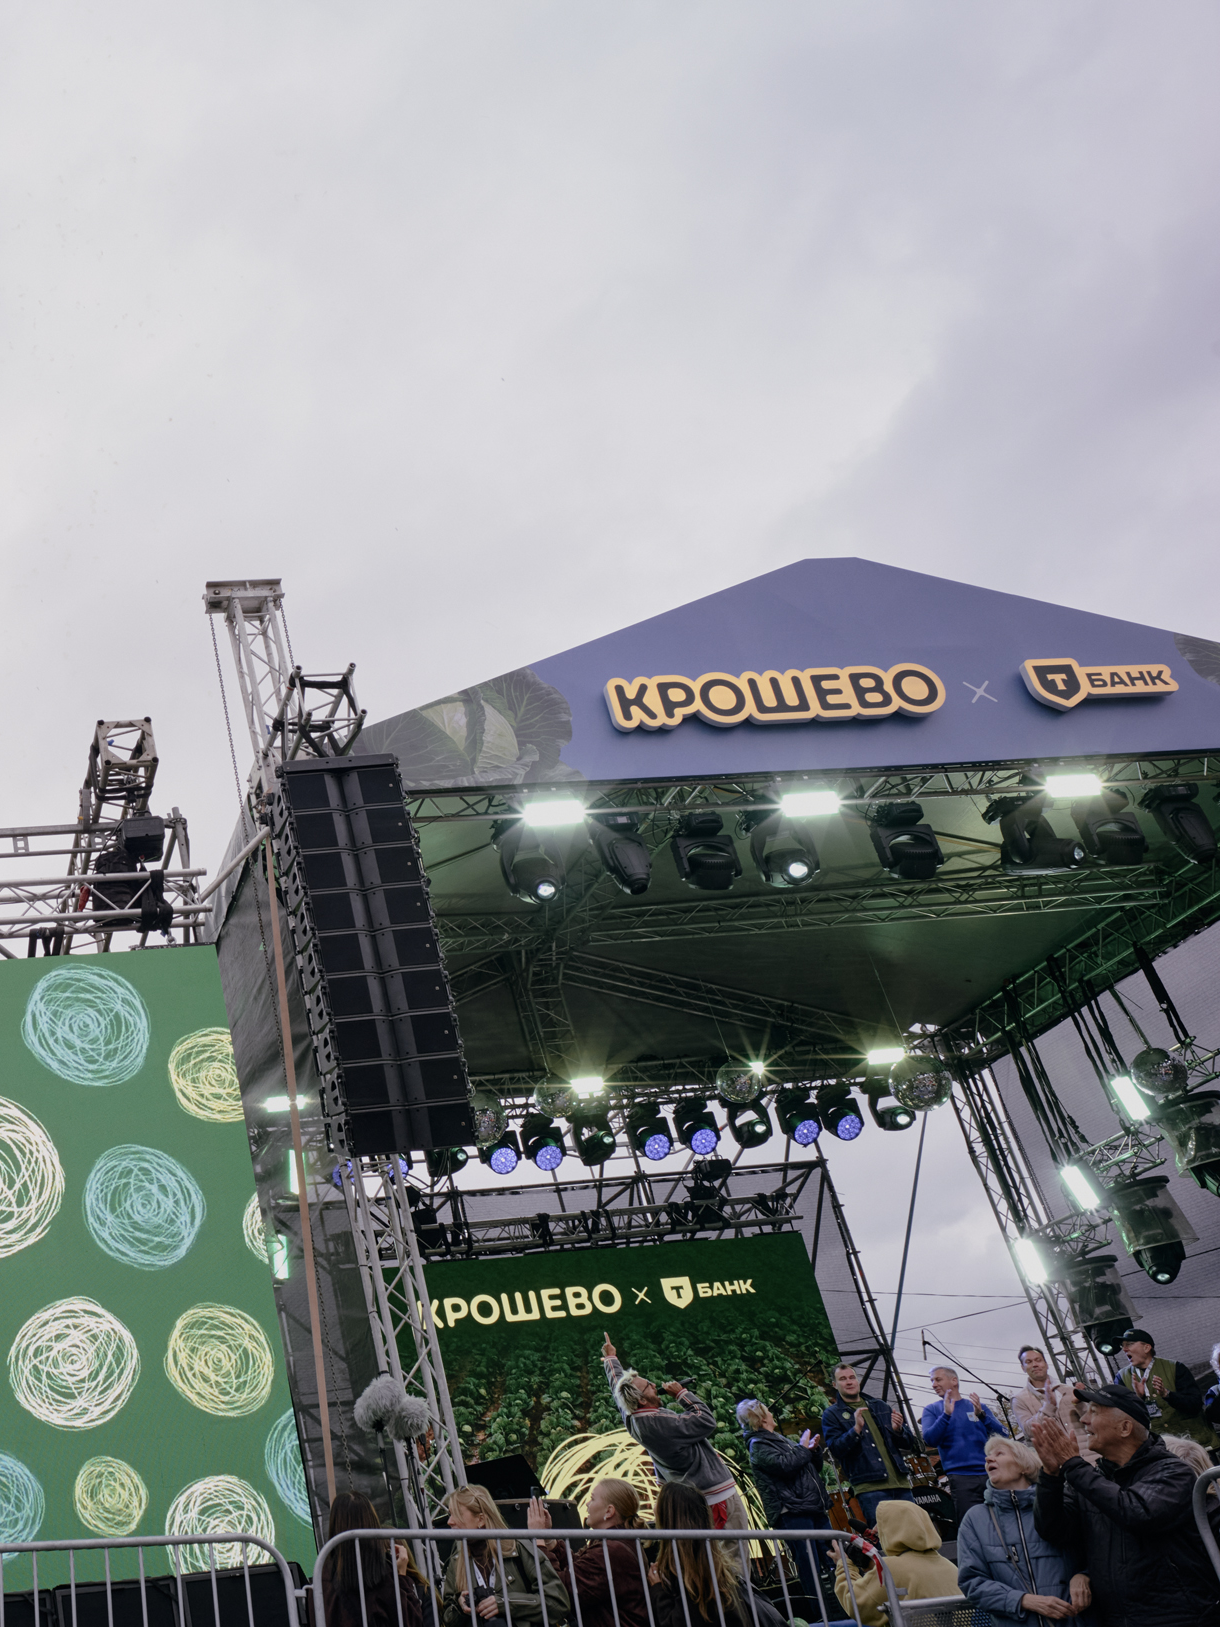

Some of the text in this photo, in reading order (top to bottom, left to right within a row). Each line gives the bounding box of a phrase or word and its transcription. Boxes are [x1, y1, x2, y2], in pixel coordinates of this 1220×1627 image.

[613, 669, 939, 721] КРОШЕВО
[1085, 669, 1172, 689] БАНК
[696, 1279, 757, 1298] БАНК
